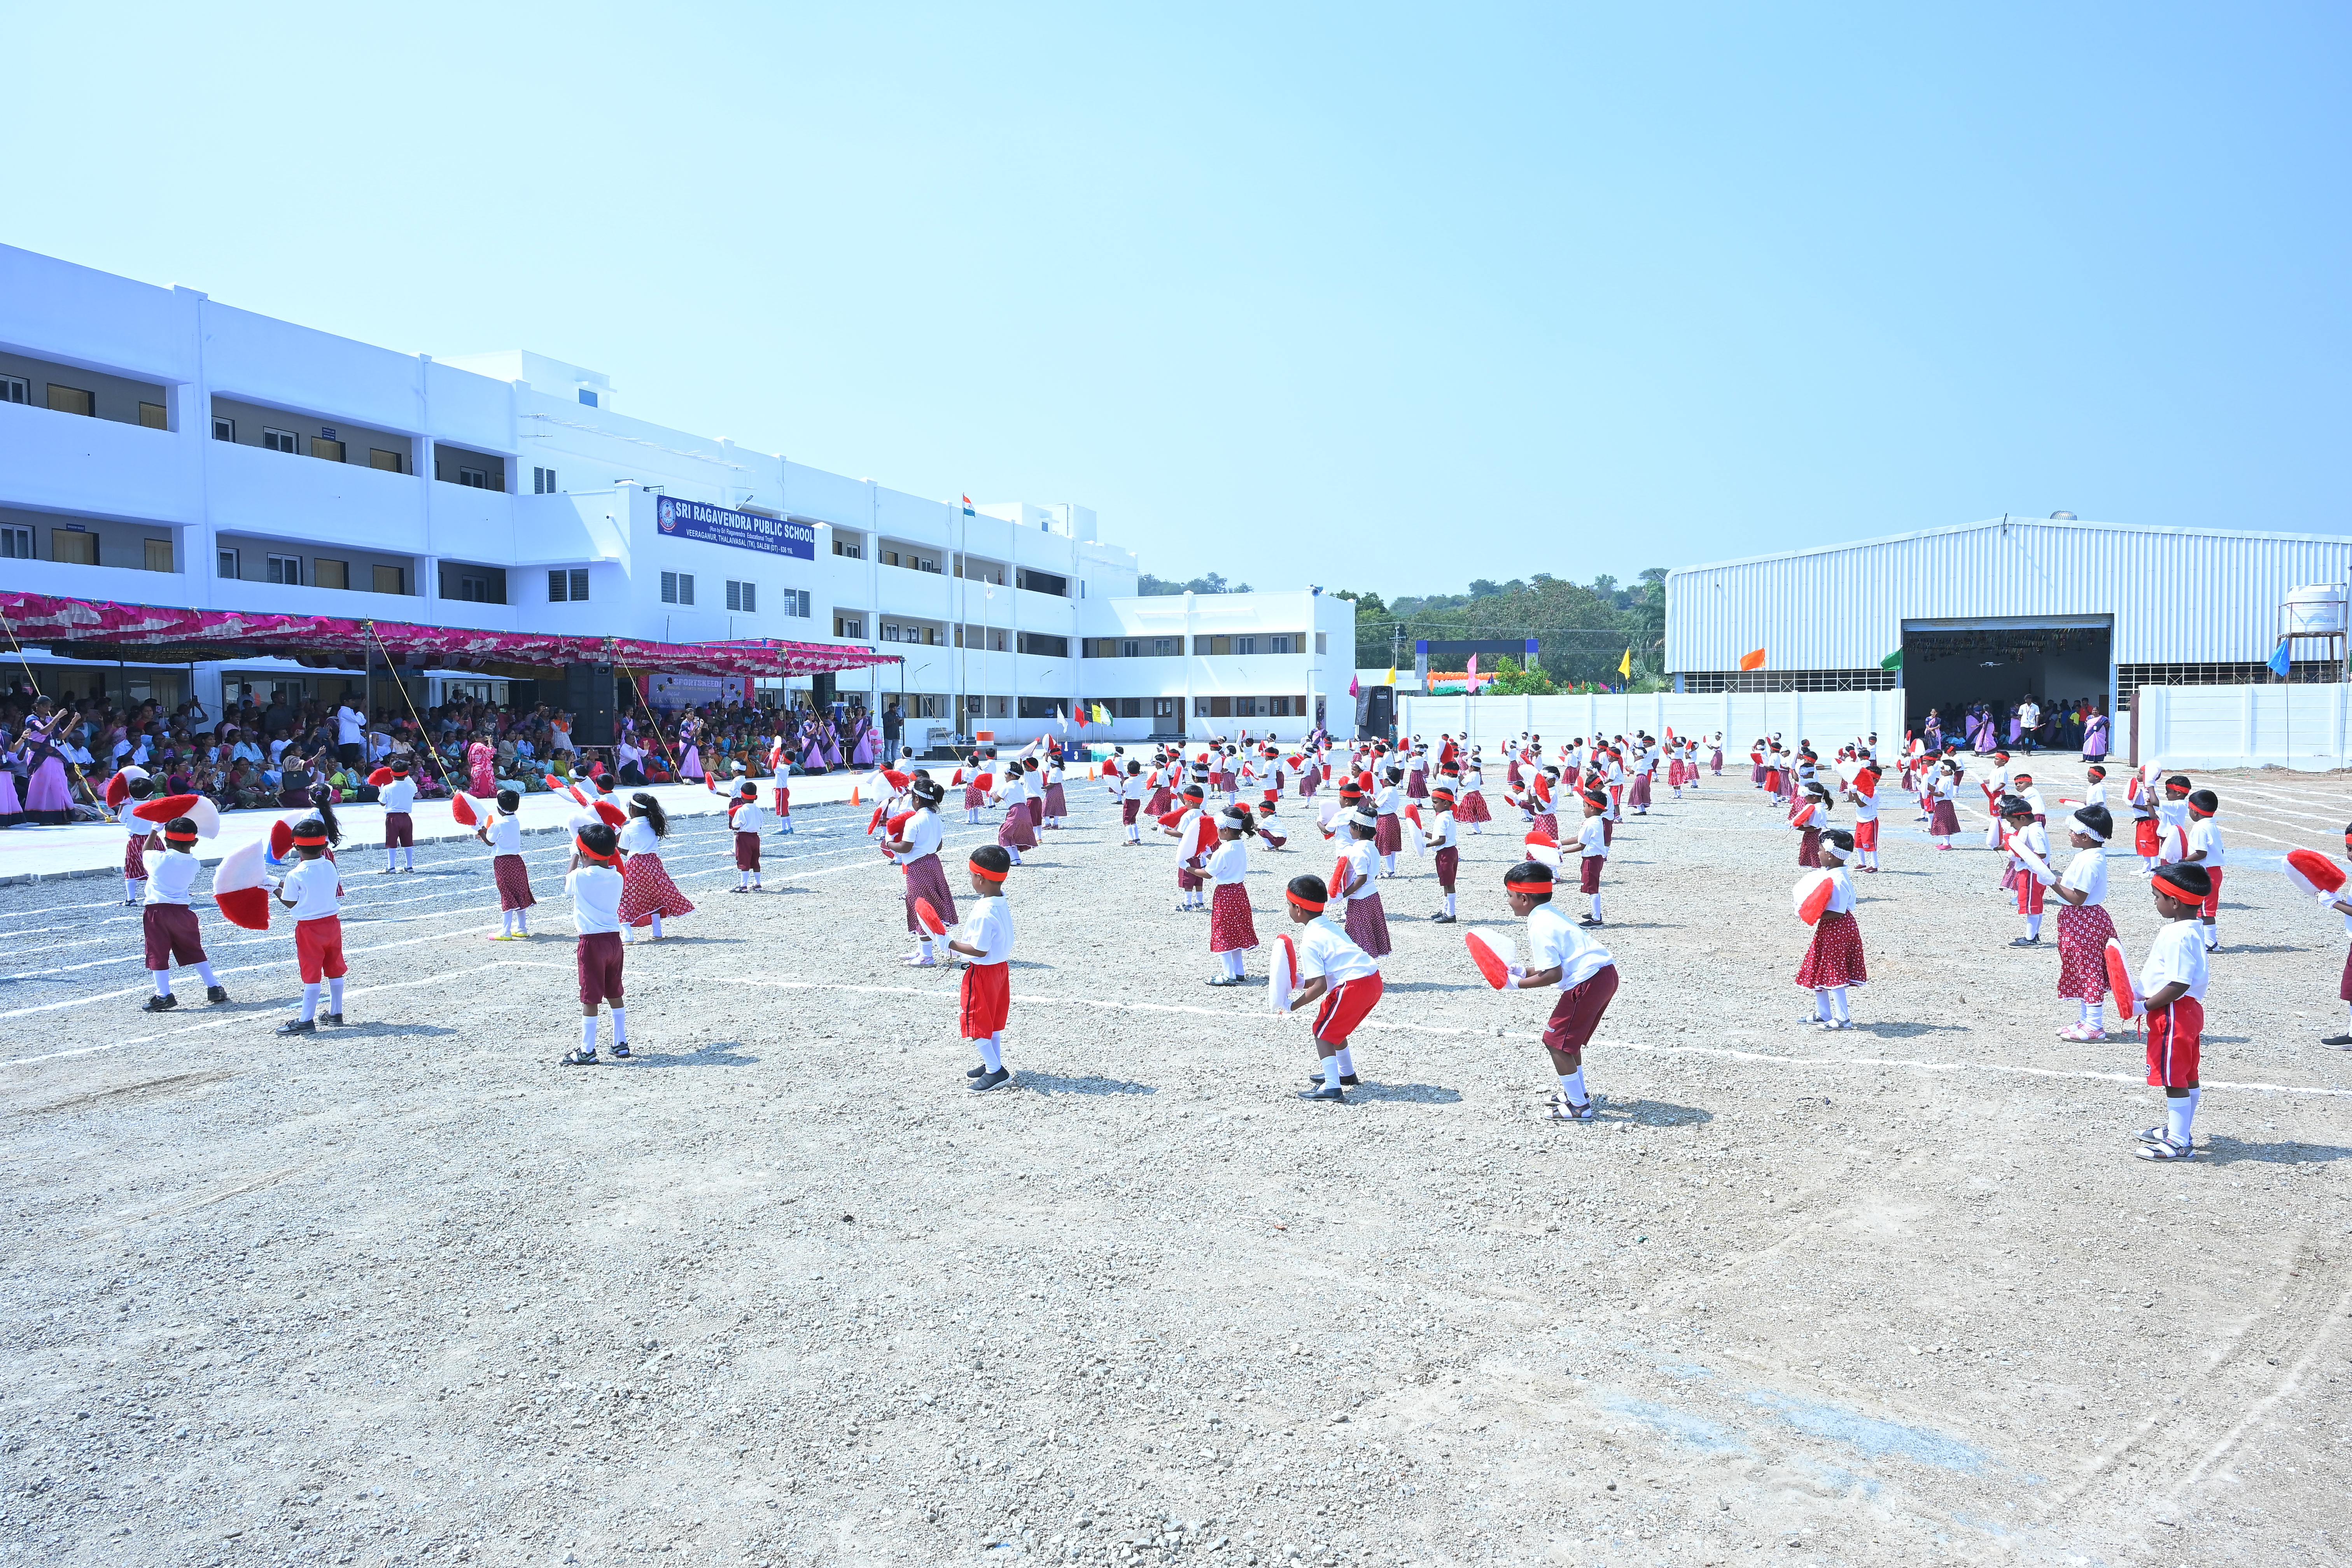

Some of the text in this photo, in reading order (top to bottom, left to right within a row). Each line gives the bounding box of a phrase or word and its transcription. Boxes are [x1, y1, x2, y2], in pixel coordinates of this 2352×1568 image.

[676, 502, 691, 519] SRI
[694, 506, 752, 531] RAGAVENDRA
[754, 518, 782, 537] PUBLIC
[784, 524, 814, 543] SCHOOL
[686, 528, 718, 542] VEERAGANUR,
[718, 535, 746, 546] THALAIVASAL
[747, 540, 756, 549] (TK),
[756, 542, 770, 550] SALEM
[1064, 741, 1068, 751] 1
[1074, 751, 1078, 760] 3
